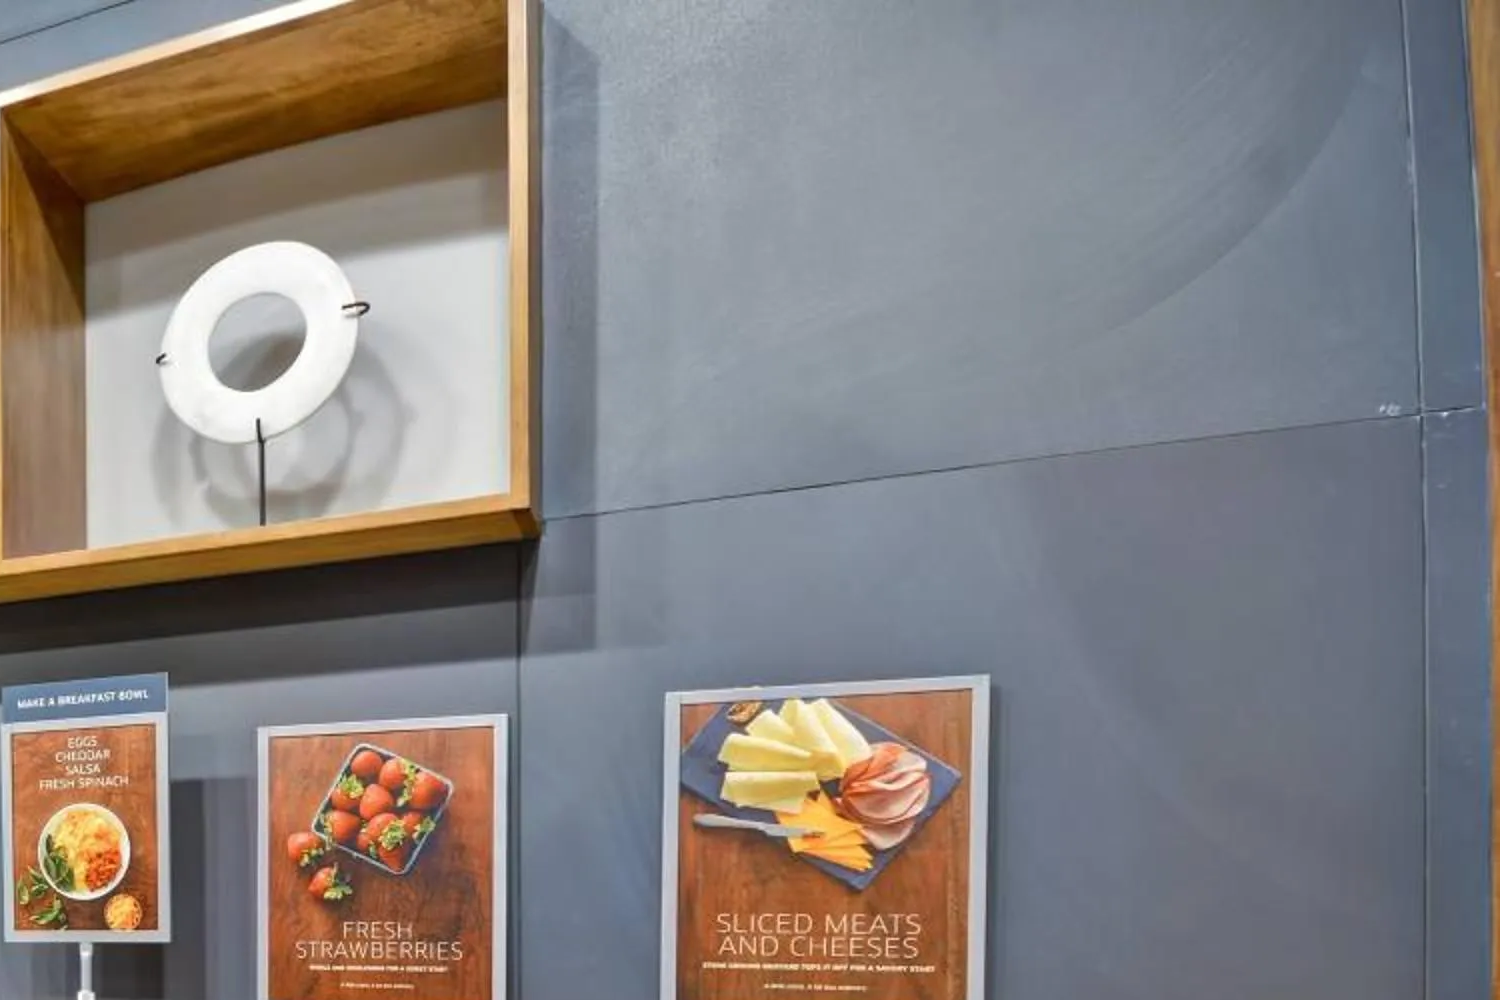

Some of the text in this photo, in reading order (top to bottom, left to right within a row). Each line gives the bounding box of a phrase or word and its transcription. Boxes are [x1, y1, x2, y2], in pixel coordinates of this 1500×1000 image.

[17, 689, 149, 709] MAKE A BREAKFAST BOWL
[67, 735, 98, 749] EGGS
[55, 749, 111, 763] CHEDDAR
[65, 763, 101, 775] SALSA
[39, 775, 129, 790] FRESH SPINACH
[343, 921, 413, 940] FRESH
[716, 913, 922, 936] SLICED MEATS
[295, 941, 464, 961] STRAWBERRIES
[718, 935, 919, 959] AND CHEESES
